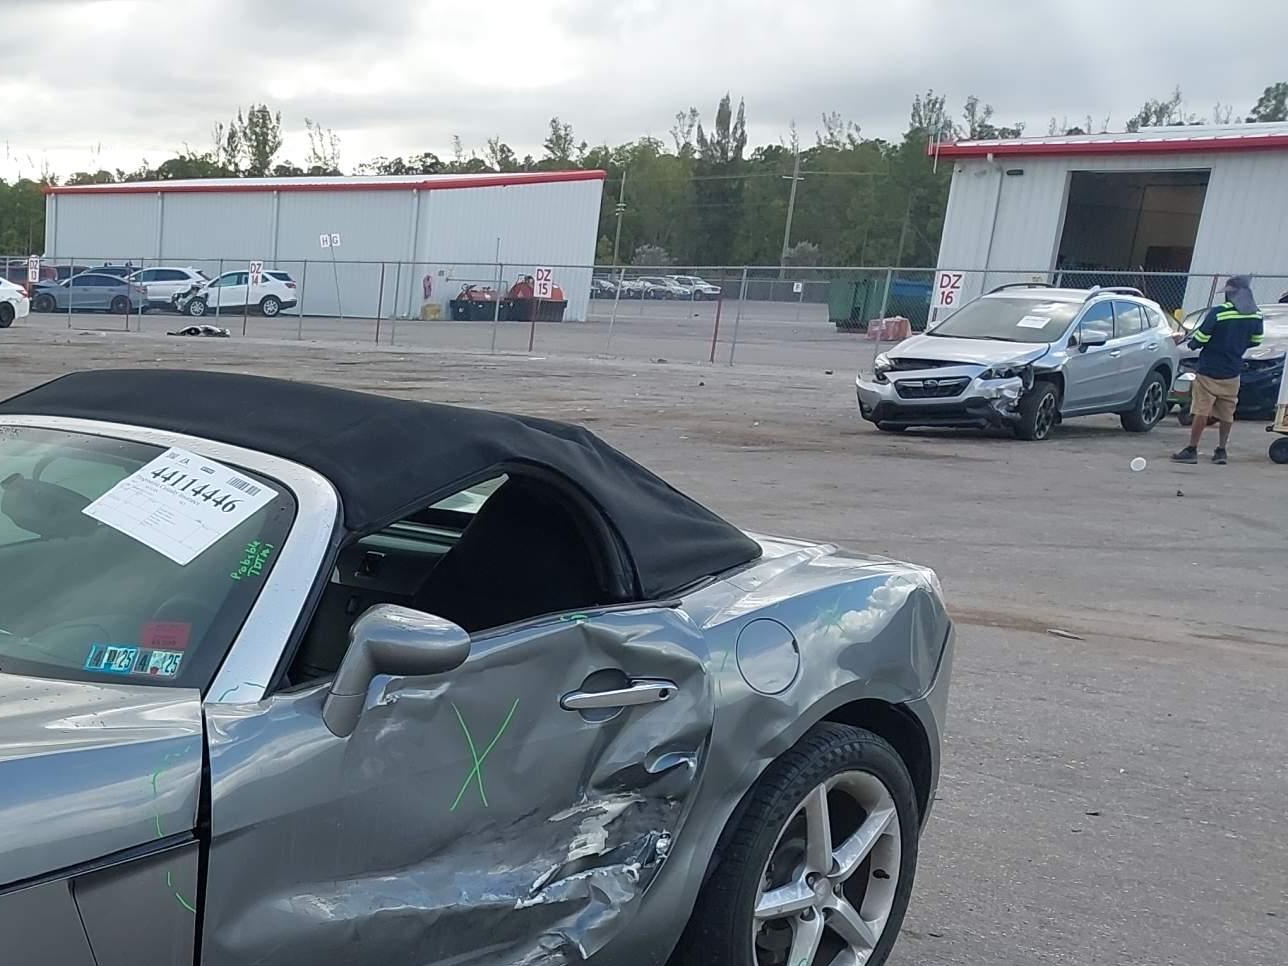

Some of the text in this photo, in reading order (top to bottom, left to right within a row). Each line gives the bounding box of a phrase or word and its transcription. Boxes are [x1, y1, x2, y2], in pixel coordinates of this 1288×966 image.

[322, 236, 328, 246] H
[332, 235, 338, 245] G
[250, 263, 262, 274] DZ
[536, 268, 552, 281] DZ
[939, 273, 962, 289] DZ
[538, 282, 548, 295] 15
[940, 290, 954, 305] 16
[151, 466, 243, 513] 44114446
[118, 649, 135, 669] 25
[138, 653, 181, 674] 4 25
